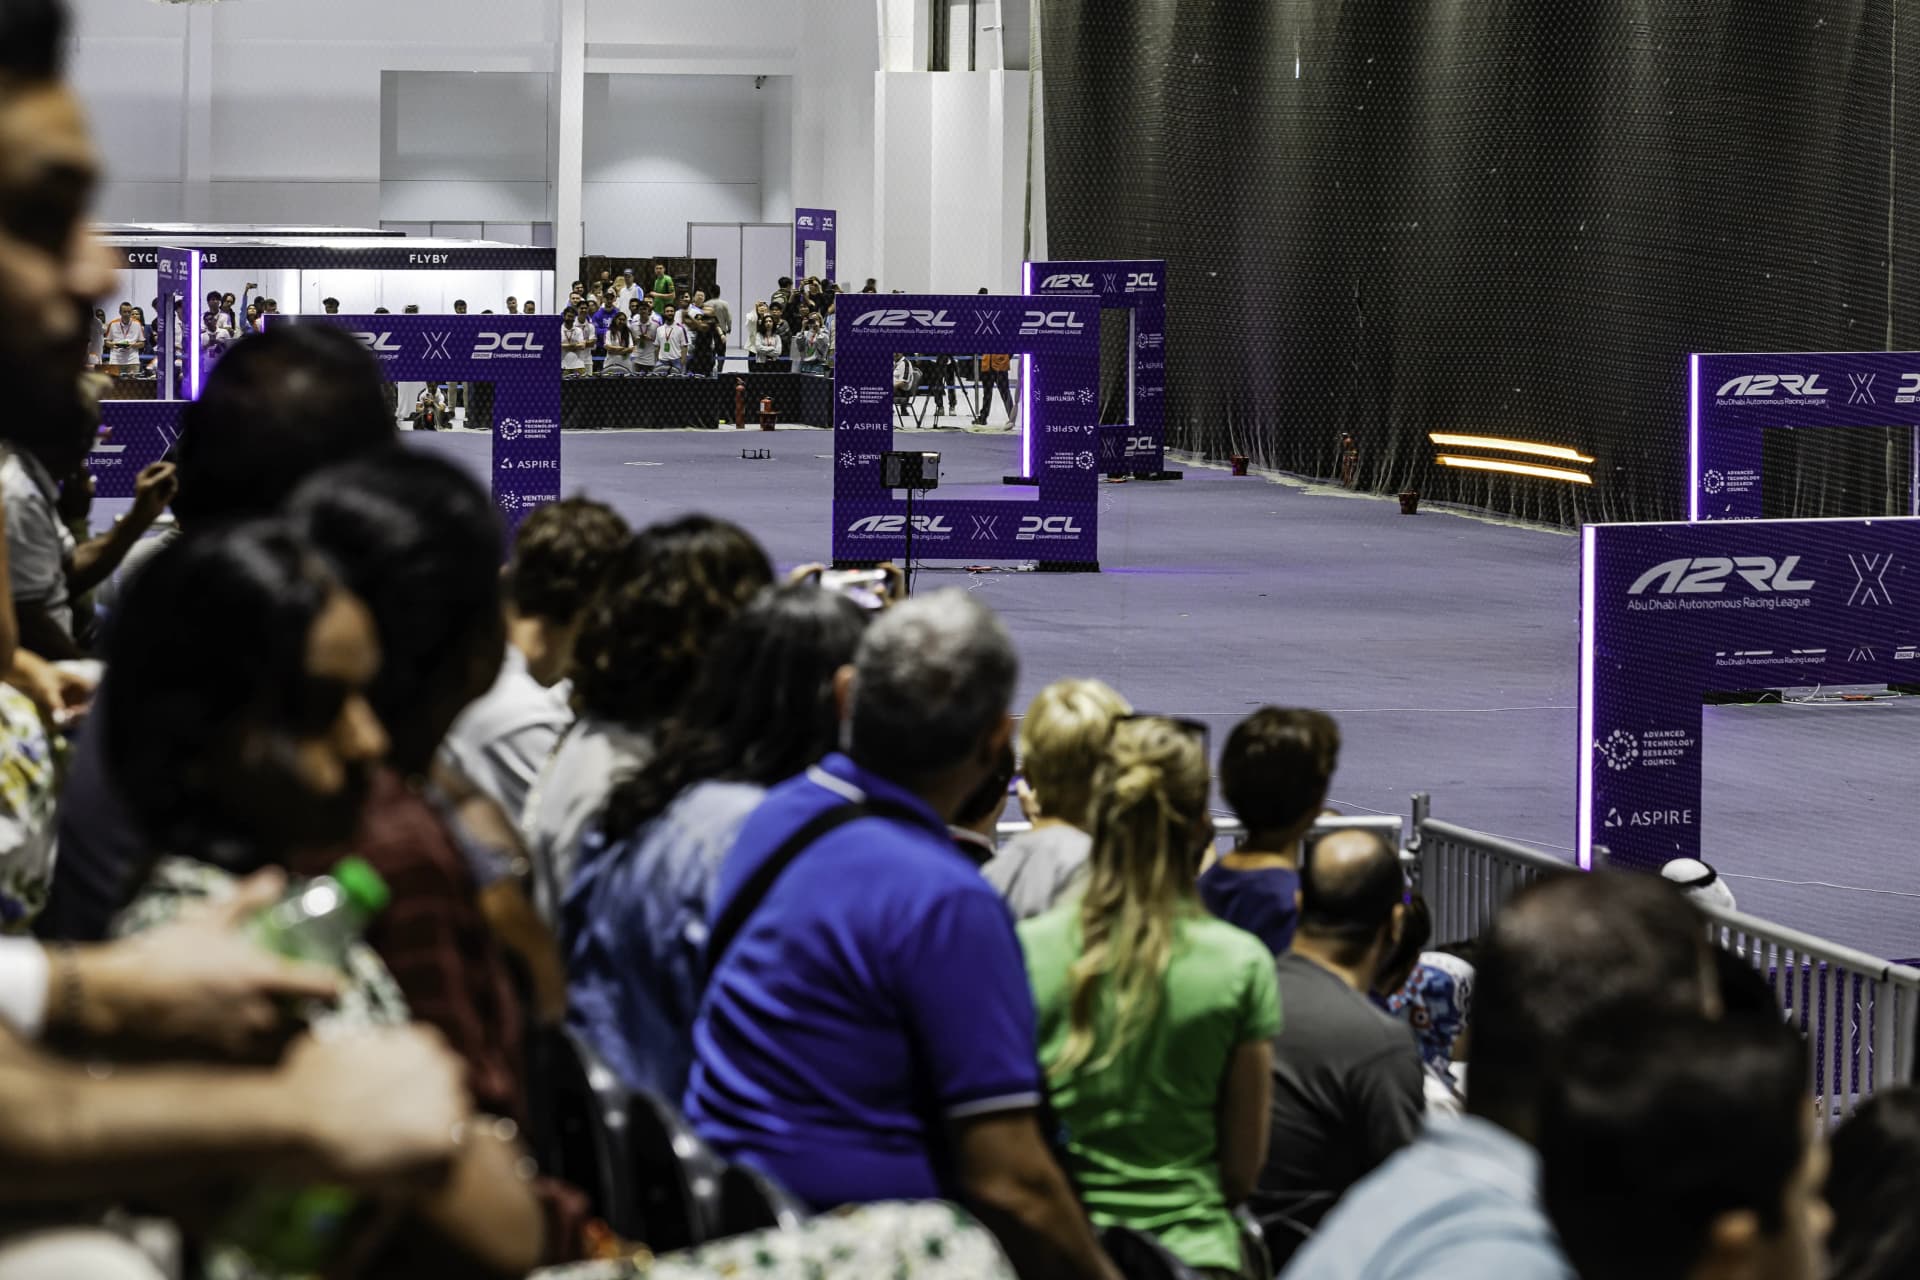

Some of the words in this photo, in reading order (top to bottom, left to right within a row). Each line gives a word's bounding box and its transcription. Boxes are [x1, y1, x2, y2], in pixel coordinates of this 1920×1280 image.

[409, 254, 448, 264] FLYBY
[1041, 274, 1094, 288] A2RL
[1126, 273, 1158, 286] DCL
[851, 310, 958, 326] A2RL
[1021, 311, 1084, 328] DCL
[474, 332, 544, 350] DCL
[1716, 375, 1829, 396] A2RL
[854, 423, 888, 431] ASPIRE
[1126, 436, 1157, 450] DCL
[90, 456, 122, 466] League
[517, 460, 558, 468] ASPIRE
[848, 515, 953, 532] A2RL
[1018, 516, 1082, 533] DCL
[1627, 556, 1816, 594] A2RL
[1627, 600, 1648, 610] Abu
[1649, 598, 1677, 610] Dhabi
[1678, 598, 1742, 609] Autonomous
[1743, 596, 1774, 610] Racing
[1775, 596, 1810, 609] League
[1643, 730, 1686, 738] ADVANCED
[1642, 749, 1684, 757] RESEARCH
[1642, 758, 1676, 766] COUNCIL
[1630, 810, 1692, 826] ASPIRE
